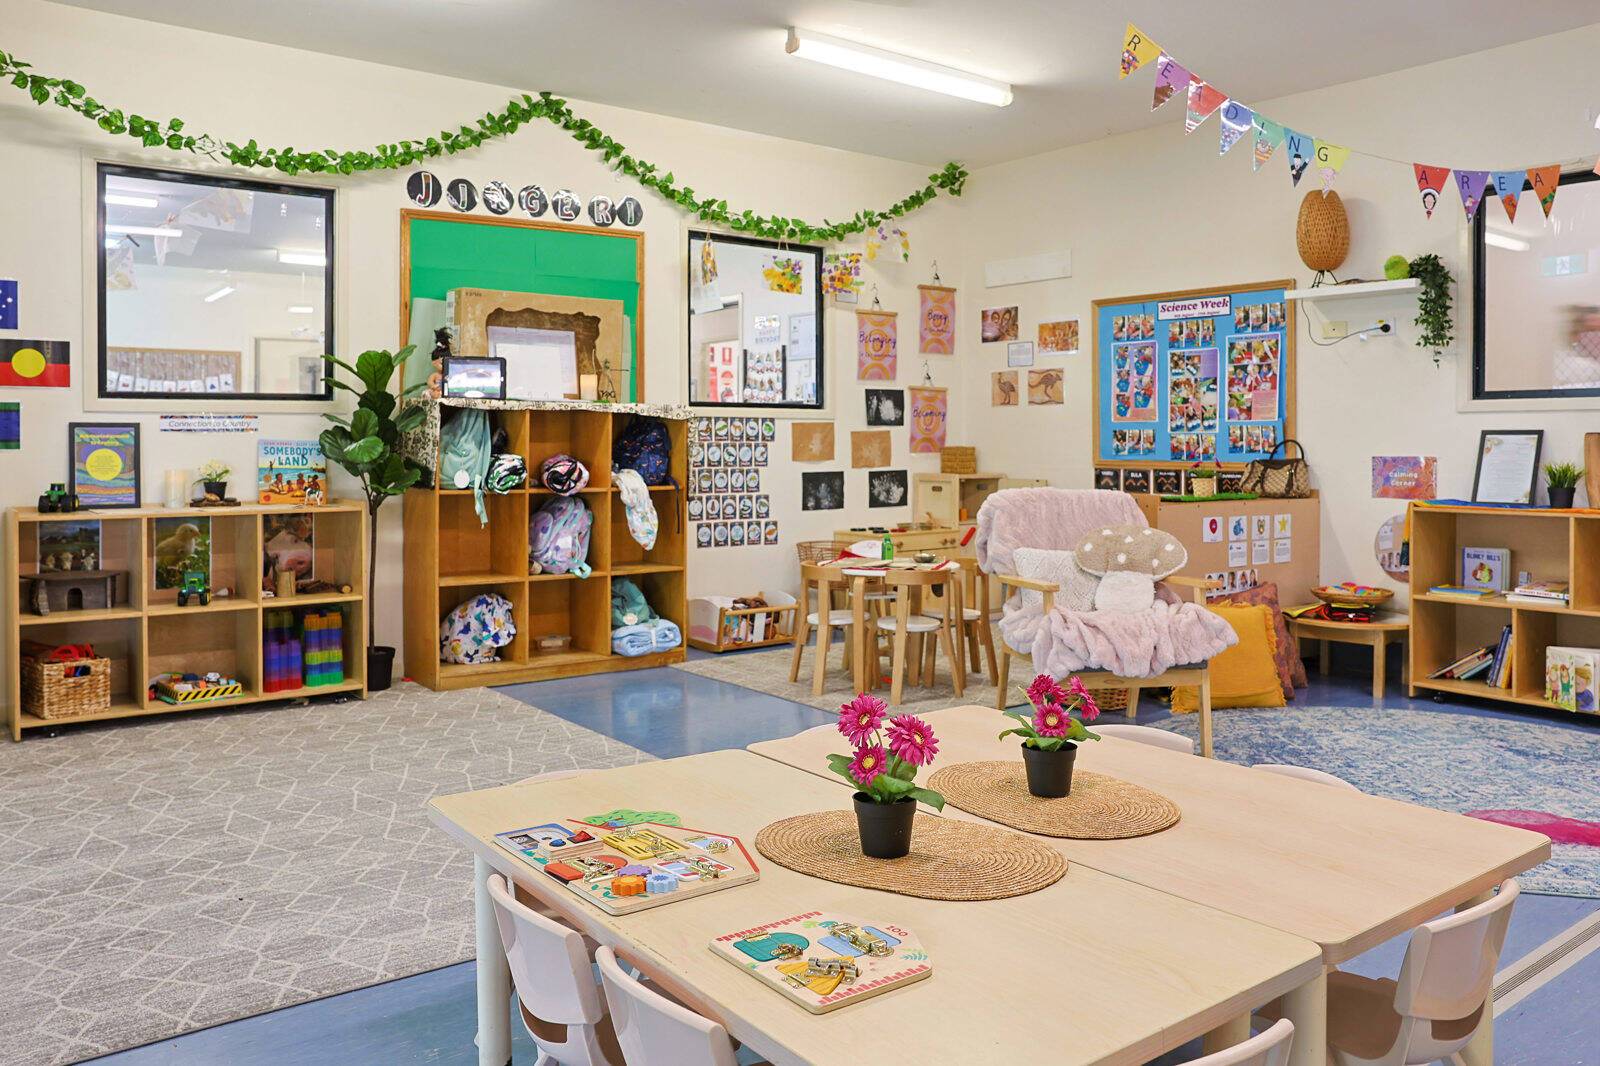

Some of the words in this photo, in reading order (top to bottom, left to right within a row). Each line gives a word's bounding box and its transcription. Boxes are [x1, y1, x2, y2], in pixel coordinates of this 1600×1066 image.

[1128, 34, 1329, 162] READING
[1418, 170, 1545, 191] AREA
[1160, 303, 1198, 313] Science
[1200, 298, 1229, 308] Week
[263, 446, 321, 456] SOMEBODY'S
[278, 456, 309, 466] LAND
